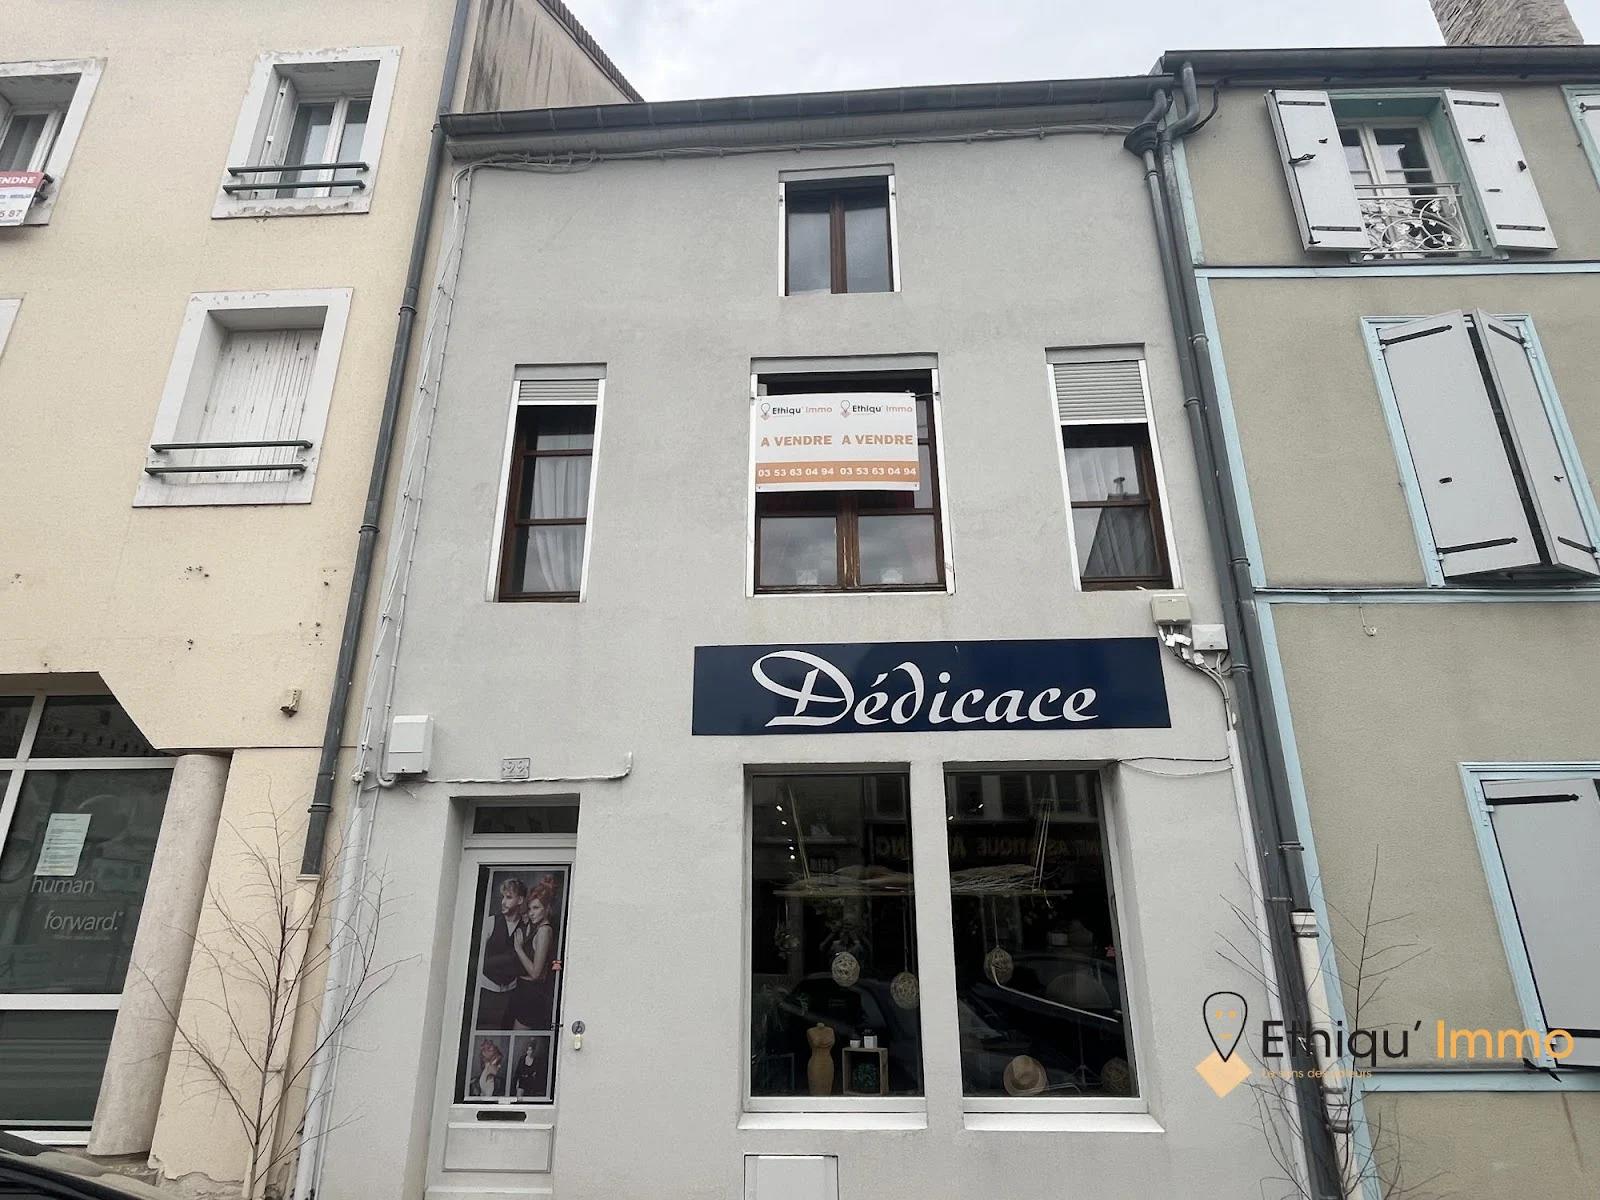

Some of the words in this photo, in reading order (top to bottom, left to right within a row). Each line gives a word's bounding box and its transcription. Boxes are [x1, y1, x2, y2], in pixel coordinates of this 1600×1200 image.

[761, 437, 770, 447] A
[775, 435, 833, 446] VENDRE
[842, 435, 851, 445] A
[855, 434, 913, 445] VENDRE
[758, 469, 771, 477] 03
[774, 469, 786, 477] 53
[805, 467, 818, 475] 04
[821, 467, 834, 475] 94
[840, 467, 853, 475] 03
[856, 467, 869, 475] 53
[872, 467, 885, 475] 63
[887, 467, 900, 475] 04
[903, 467, 916, 475] 94
[751, 650, 1099, 728] Dédicace
[30, 875, 95, 894] human
